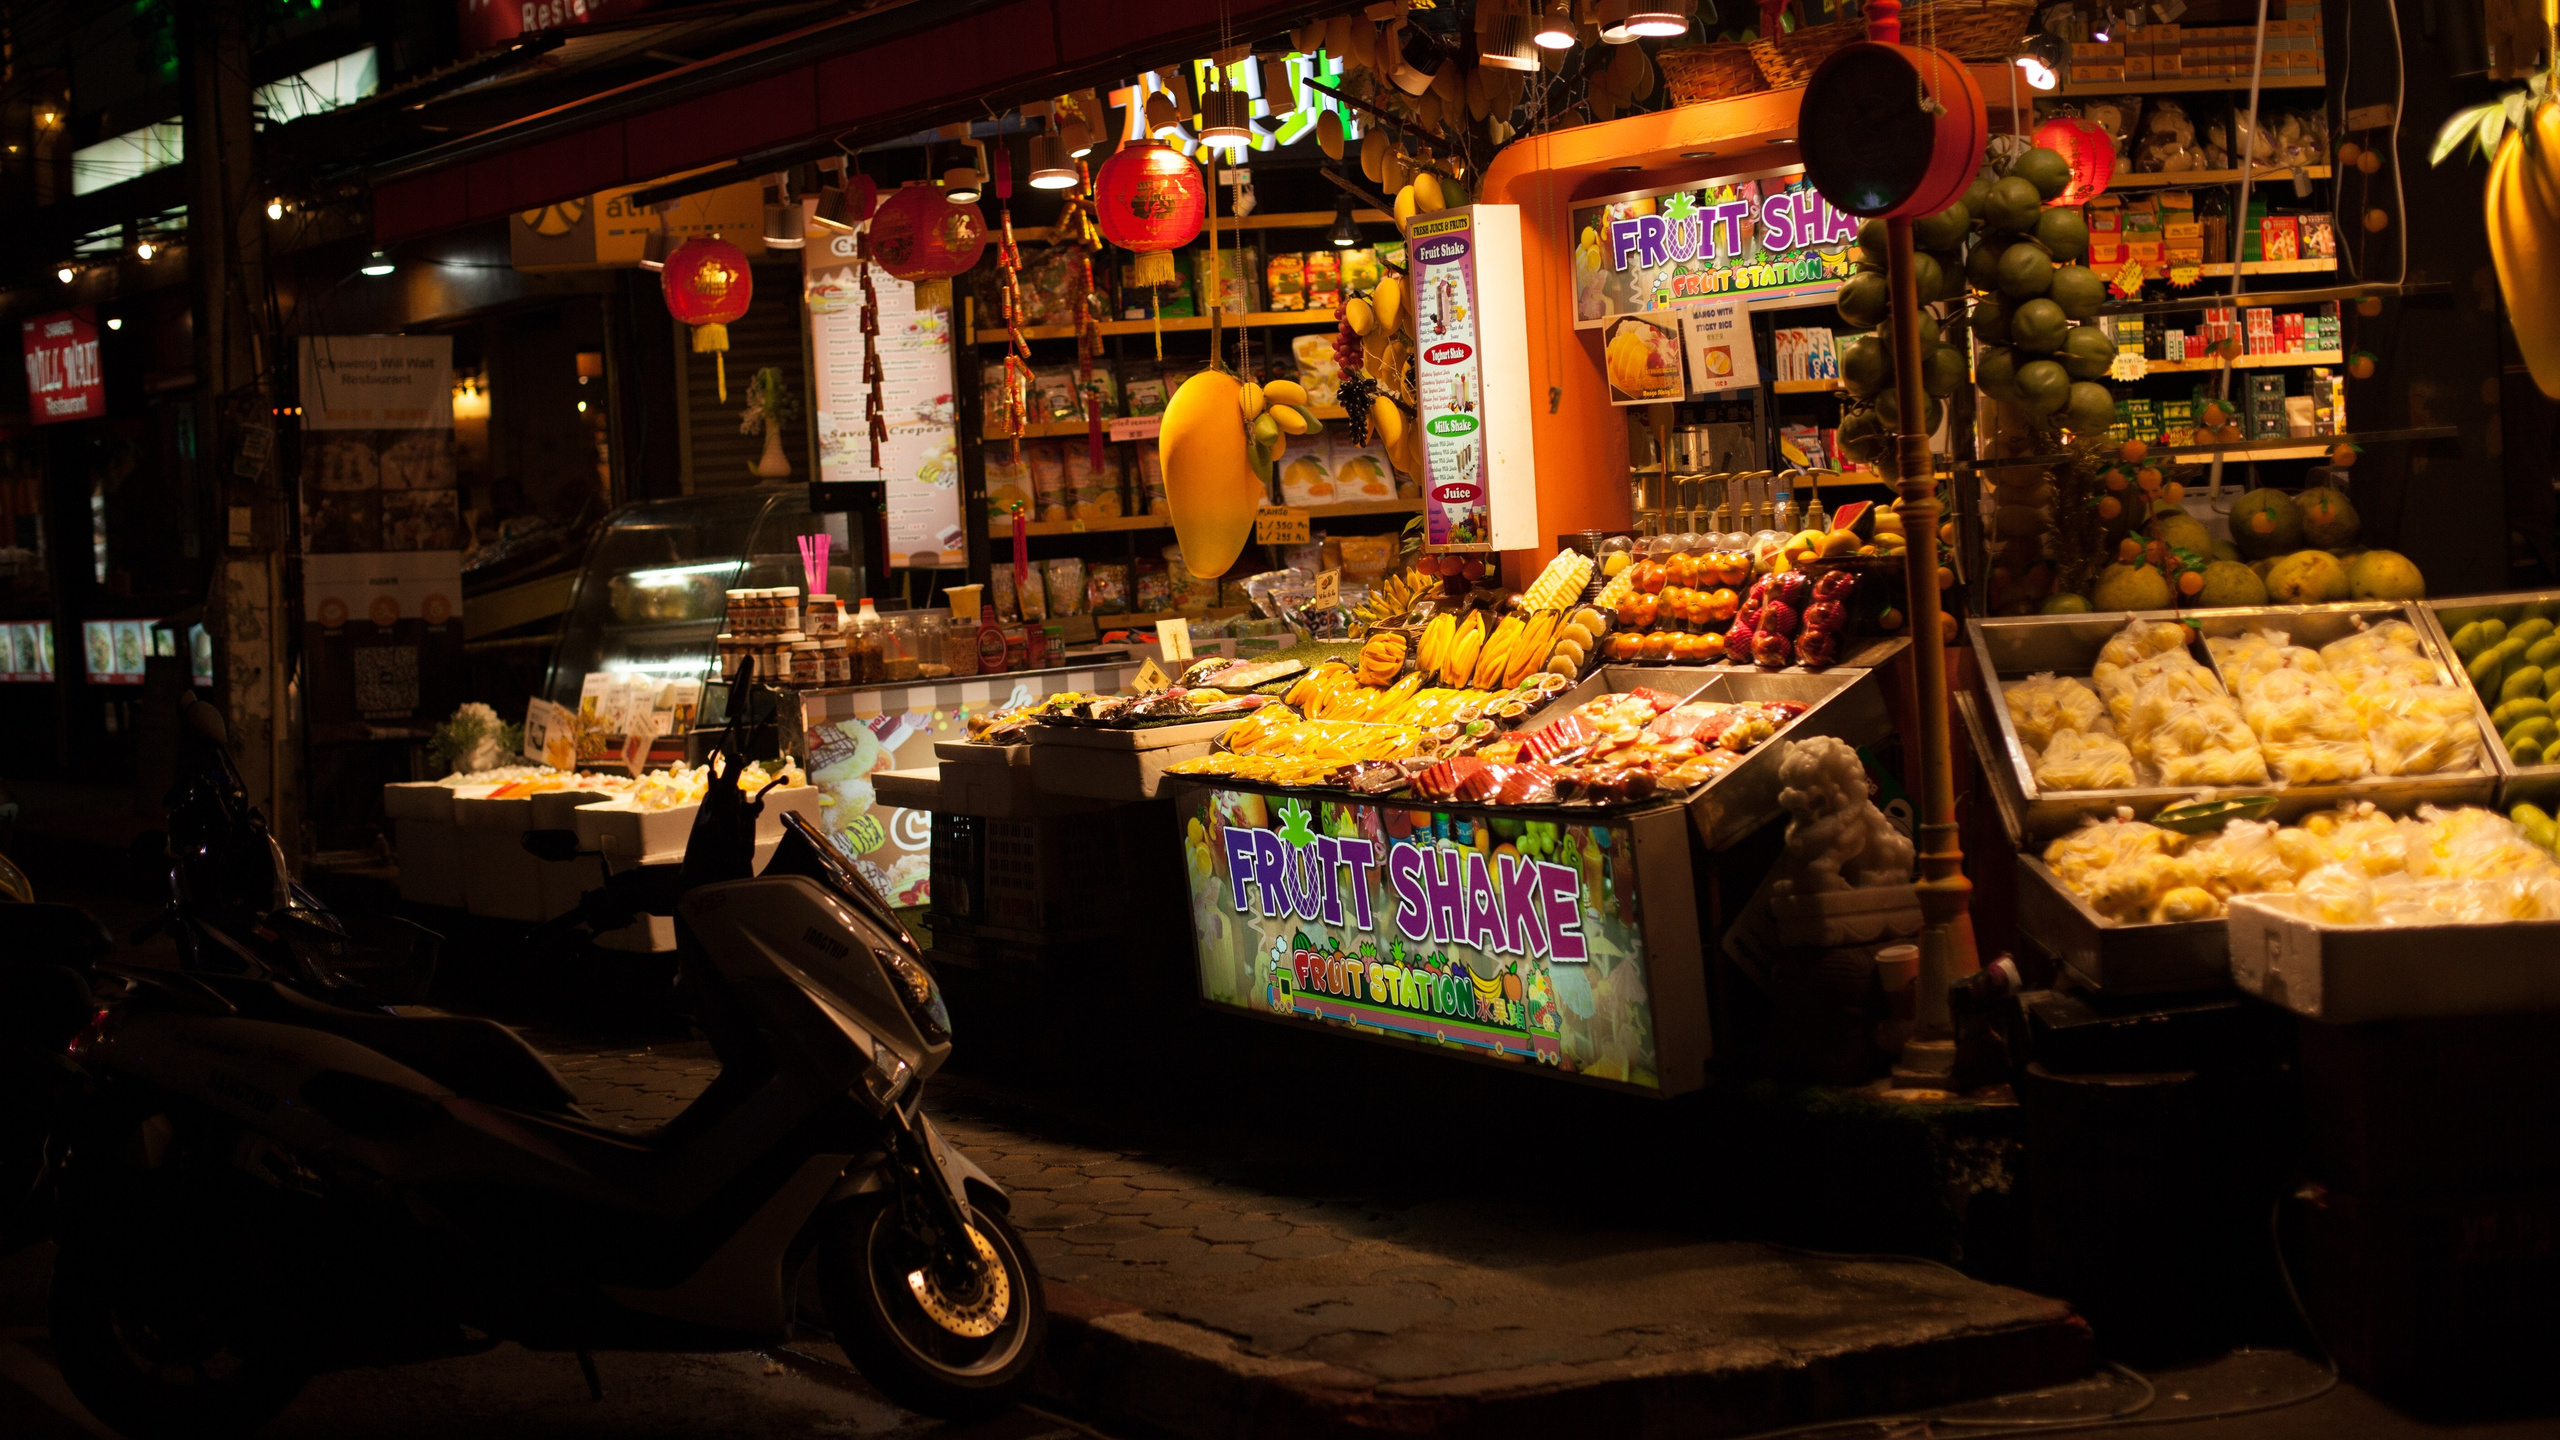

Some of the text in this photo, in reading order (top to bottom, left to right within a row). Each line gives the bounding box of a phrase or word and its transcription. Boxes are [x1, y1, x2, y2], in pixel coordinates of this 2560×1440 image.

[1413, 225, 1429, 237] FRESH
[1430, 222, 1444, 232] JUICE
[1449, 218, 1468, 230] FRUITS
[1611, 188, 1859, 272] FRUIT SHA
[1420, 242, 1465, 260] Fruit Shake
[1672, 270, 1733, 298] FRUIT
[1735, 257, 1822, 289] STATION
[1693, 307, 1733, 319] MANGO WITH
[1696, 321, 1732, 332] STICKY RICE
[1431, 347, 1465, 364] Yoghurt Shake
[341, 374, 412, 386] Restaurant
[889, 426, 942, 437] Crepes
[1435, 419, 1472, 434] Milk Shake
[1443, 487, 1471, 499] Juice
[1223, 825, 1589, 963] FRUIT SHAKE
[1293, 947, 1526, 1030] FRUIT STATION 水果站
